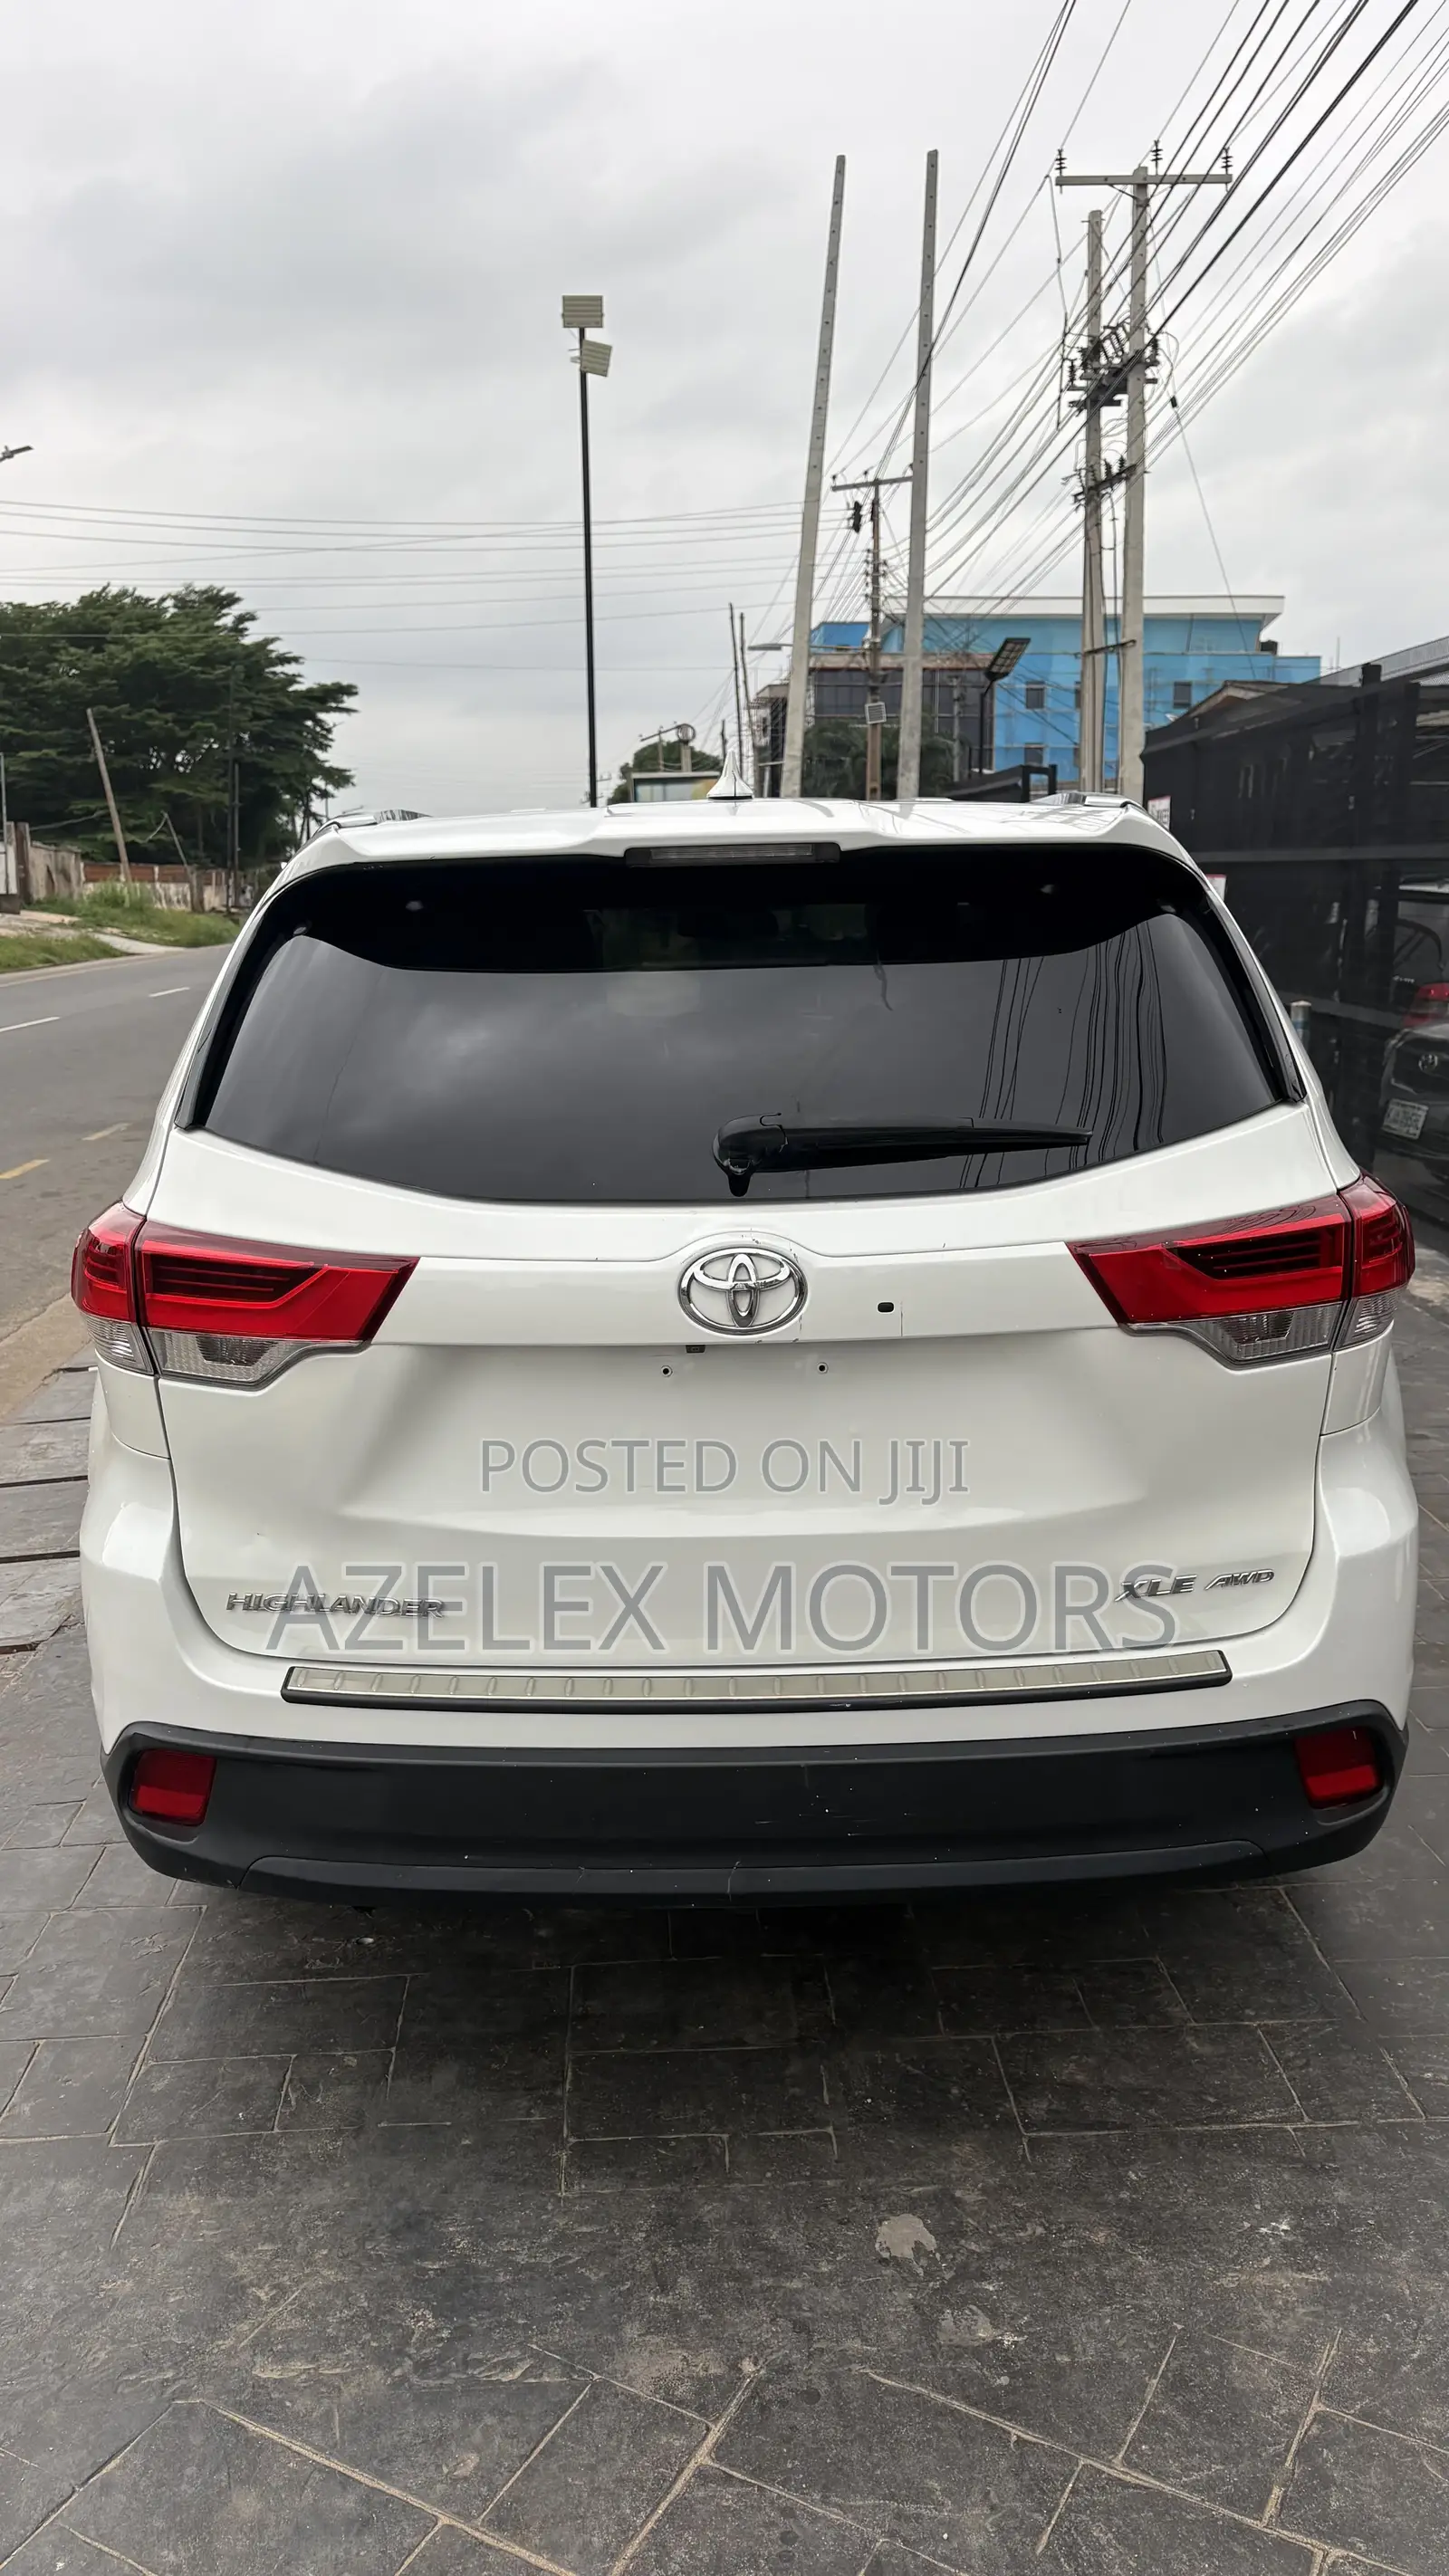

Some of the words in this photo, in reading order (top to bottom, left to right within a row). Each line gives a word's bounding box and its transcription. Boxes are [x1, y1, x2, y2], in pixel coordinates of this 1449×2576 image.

[1114, 1574, 1198, 1603] XLE
[1204, 1568, 1275, 1591] AWD
[226, 1592, 446, 1619] HIGHLANDER
